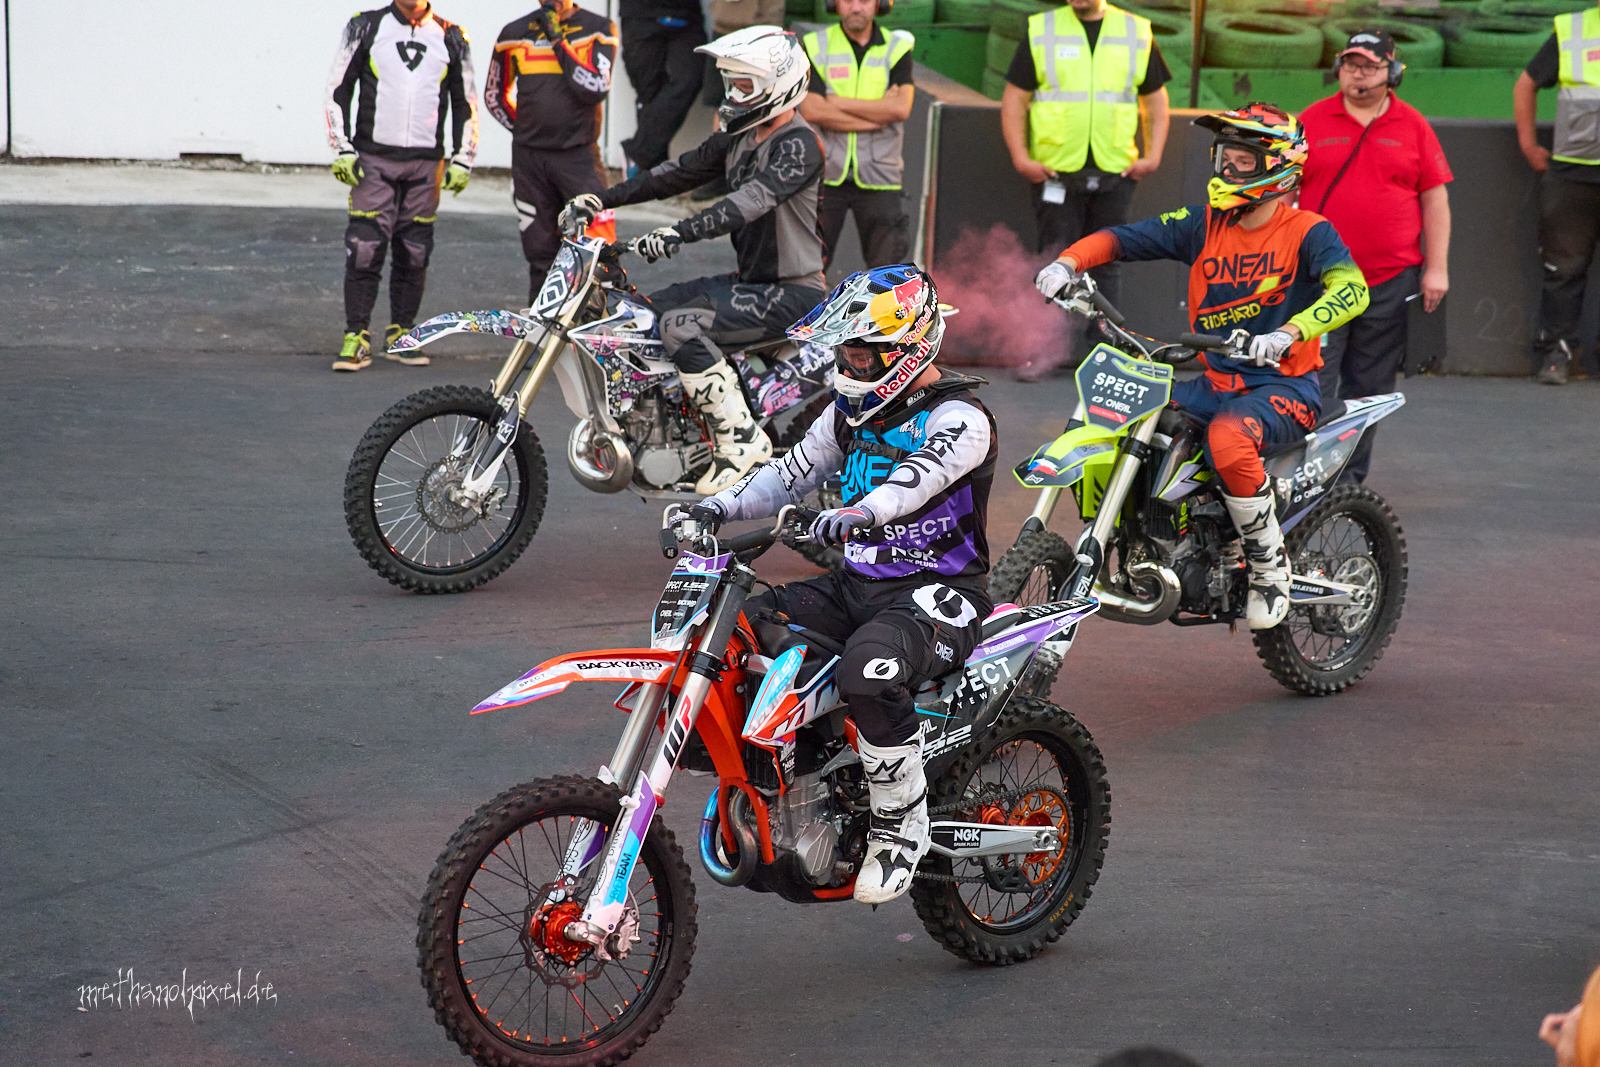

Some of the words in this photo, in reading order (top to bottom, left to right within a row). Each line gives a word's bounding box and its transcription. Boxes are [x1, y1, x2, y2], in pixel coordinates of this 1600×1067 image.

[691, 206, 730, 235] FOX
[664, 314, 702, 333] FOX
[1094, 372, 1149, 399] SPECT
[1091, 384, 1142, 405] EYEWEAR
[1105, 399, 1132, 414] ONEAL
[886, 421, 968, 489] ONEAL
[1277, 457, 1325, 492] SPECT
[1304, 485, 1325, 499] ONEAL
[884, 516, 951, 541] SPECT
[891, 546, 937, 562] NGK
[914, 559, 939, 568] PLUGS
[1055, 615, 1076, 627] ONEAL
[577, 662, 662, 670] BACKYARD
[518, 673, 546, 687] SPECT
[953, 829, 980, 841] NGK
[1049, 892, 1074, 923] MAXXIS
